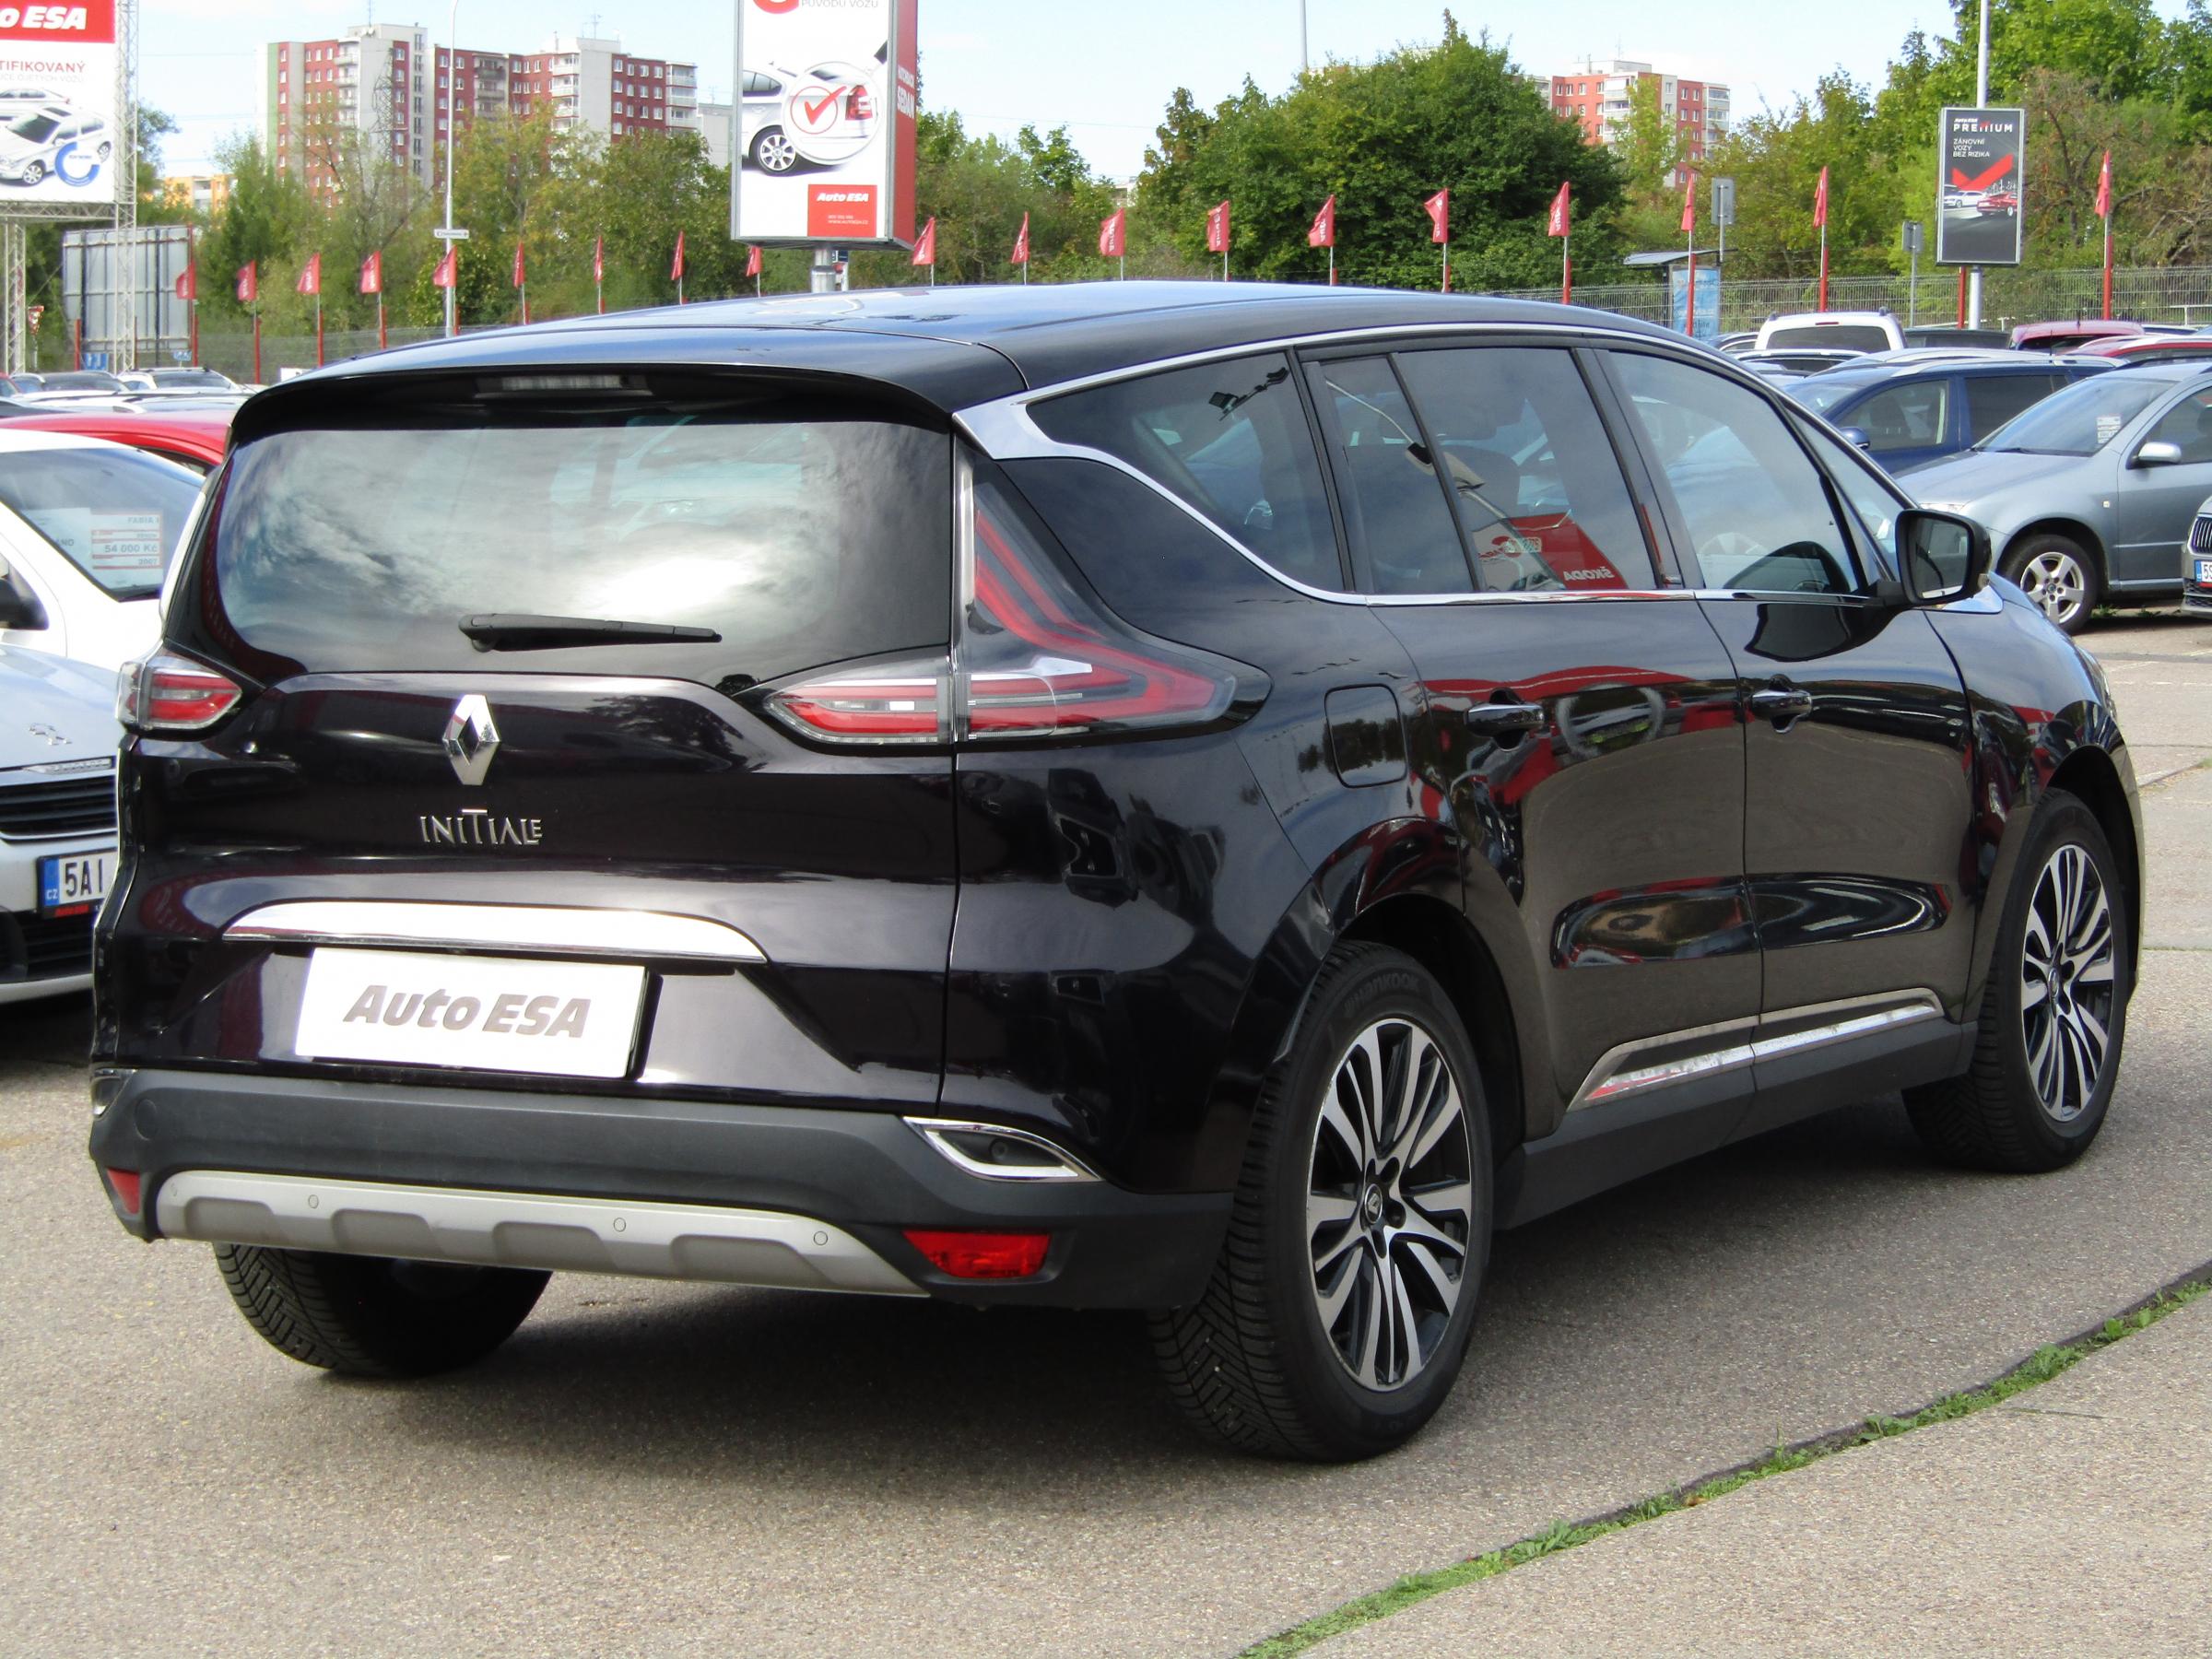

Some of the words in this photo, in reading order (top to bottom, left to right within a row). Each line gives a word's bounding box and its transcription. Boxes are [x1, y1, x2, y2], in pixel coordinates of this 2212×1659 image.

[21, 6, 88, 30] ESA
[897, 86, 915, 119] SEDAN
[1953, 123, 2013, 133] PREMIUM
[816, 192, 846, 202] Auto
[846, 192, 869, 202] ESA
[104, 545, 118, 553] 54
[121, 545, 140, 553] 000
[419, 807, 544, 846] INITIALE
[46, 890, 59, 900] CZ
[342, 983, 483, 1032] Auto
[482, 994, 592, 1039] ESA
